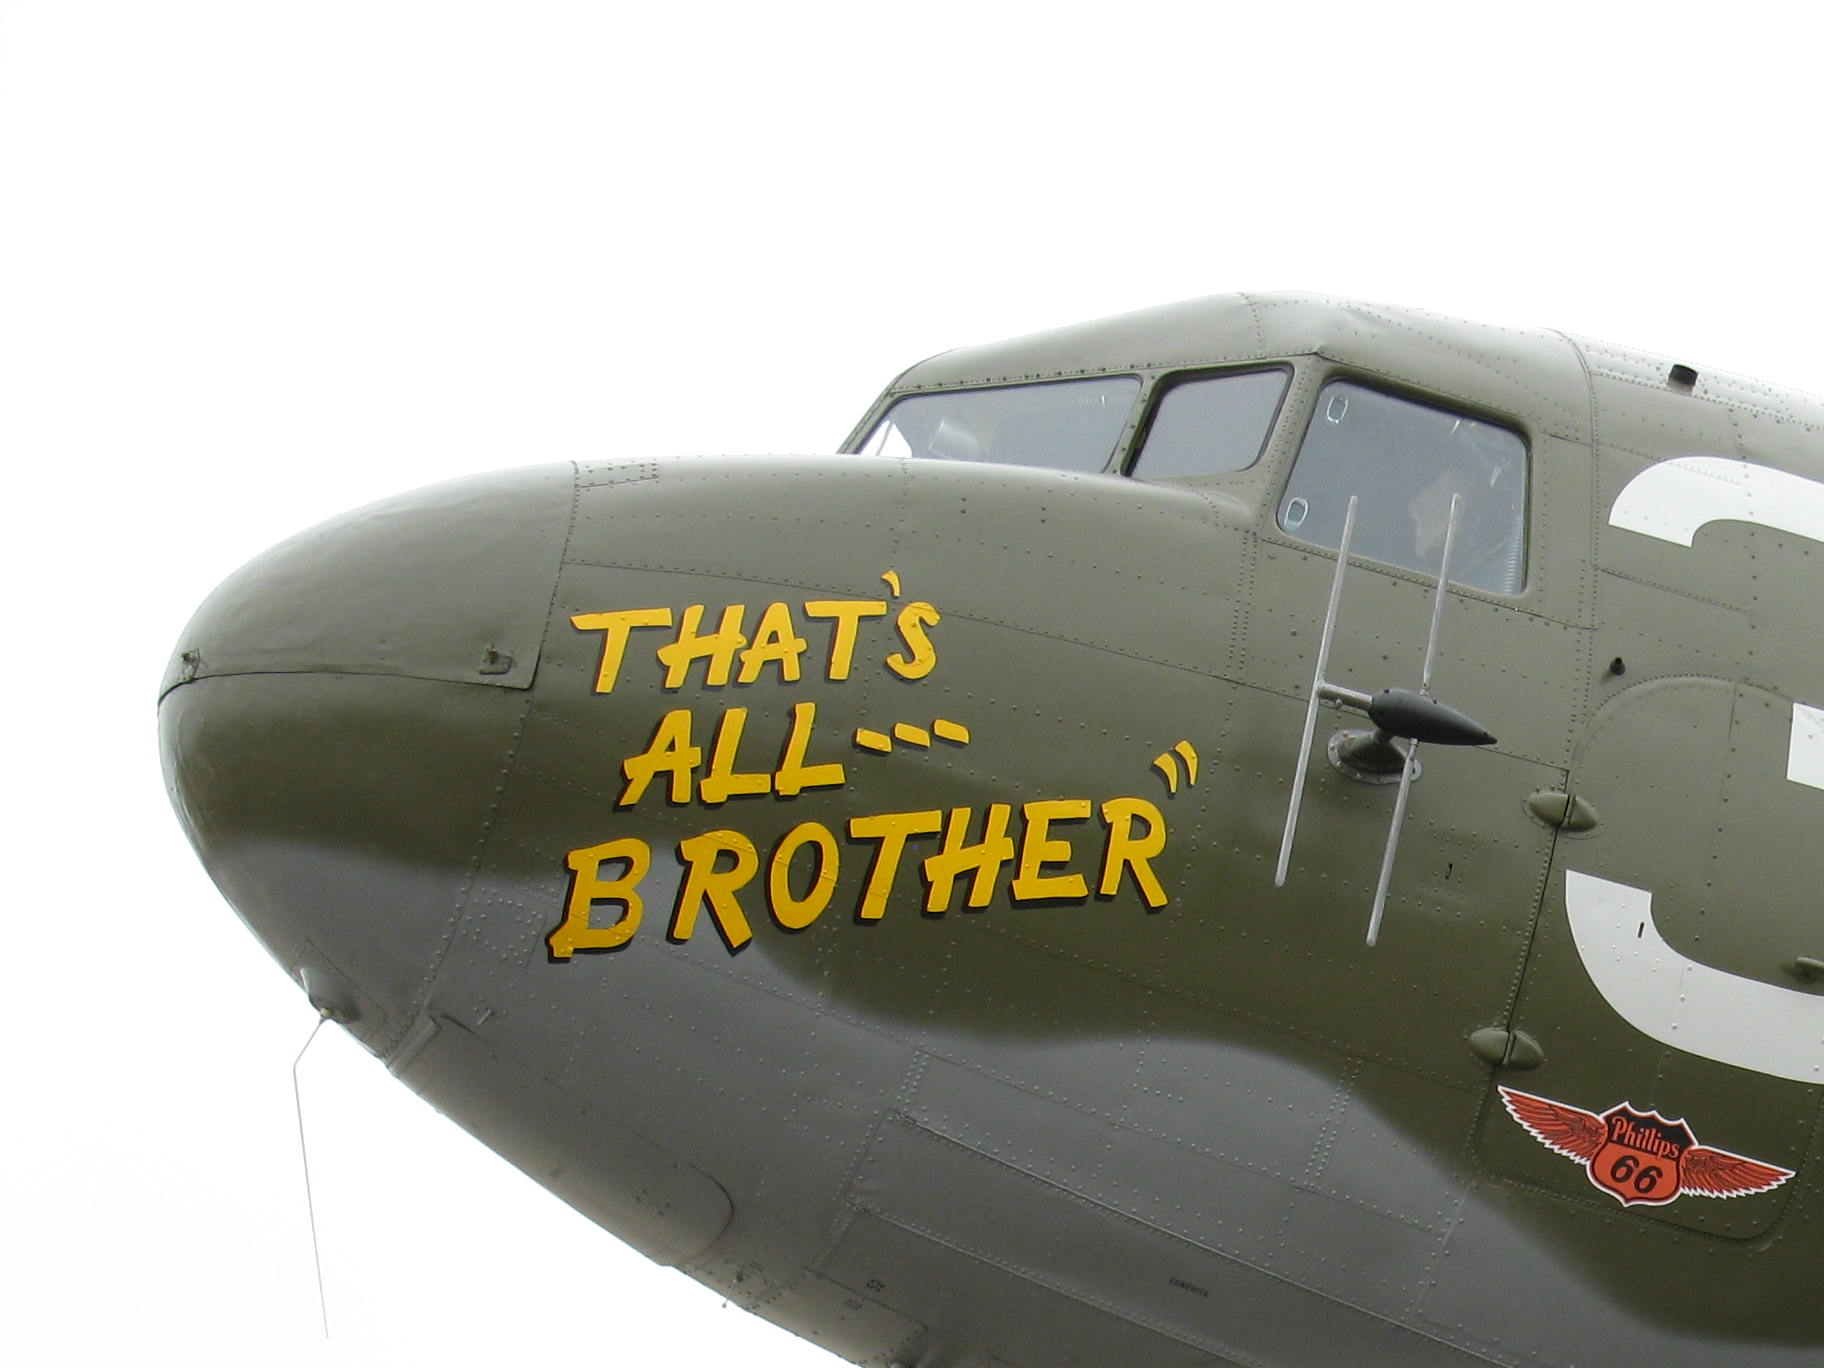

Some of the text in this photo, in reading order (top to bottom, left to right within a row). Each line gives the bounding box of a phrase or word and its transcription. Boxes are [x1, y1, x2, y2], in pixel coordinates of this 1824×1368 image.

[569, 569, 942, 695] THAT'S
[1611, 1115, 1680, 1160] Phillips
[1610, 1155, 1663, 1194] 66
